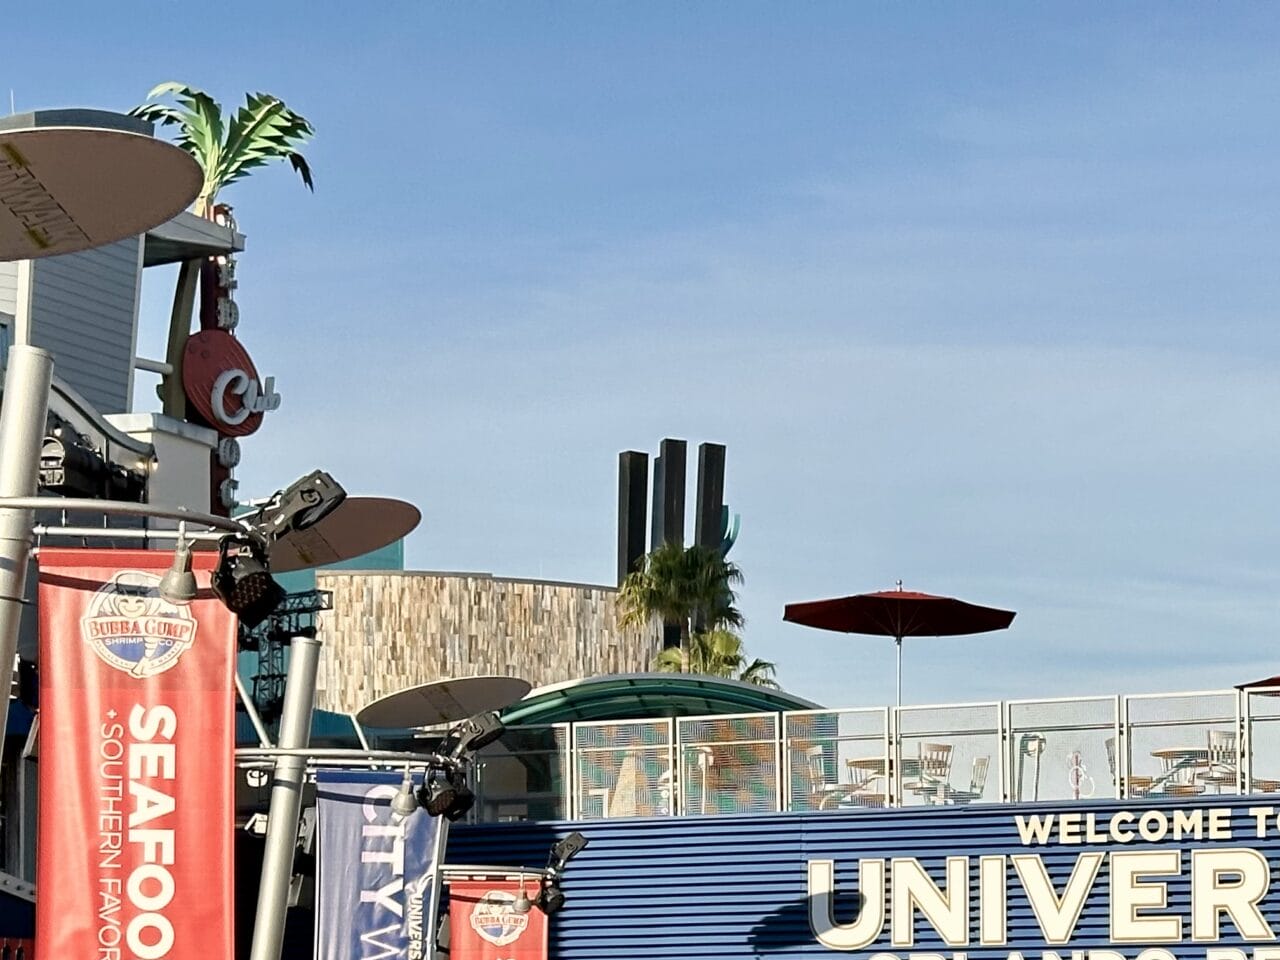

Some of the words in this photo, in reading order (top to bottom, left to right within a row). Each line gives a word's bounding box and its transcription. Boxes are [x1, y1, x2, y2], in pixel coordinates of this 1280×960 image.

[89, 620, 141, 637] BUBBA
[144, 619, 190, 637] GUMP
[1014, 808, 1232, 846] WELCOME
